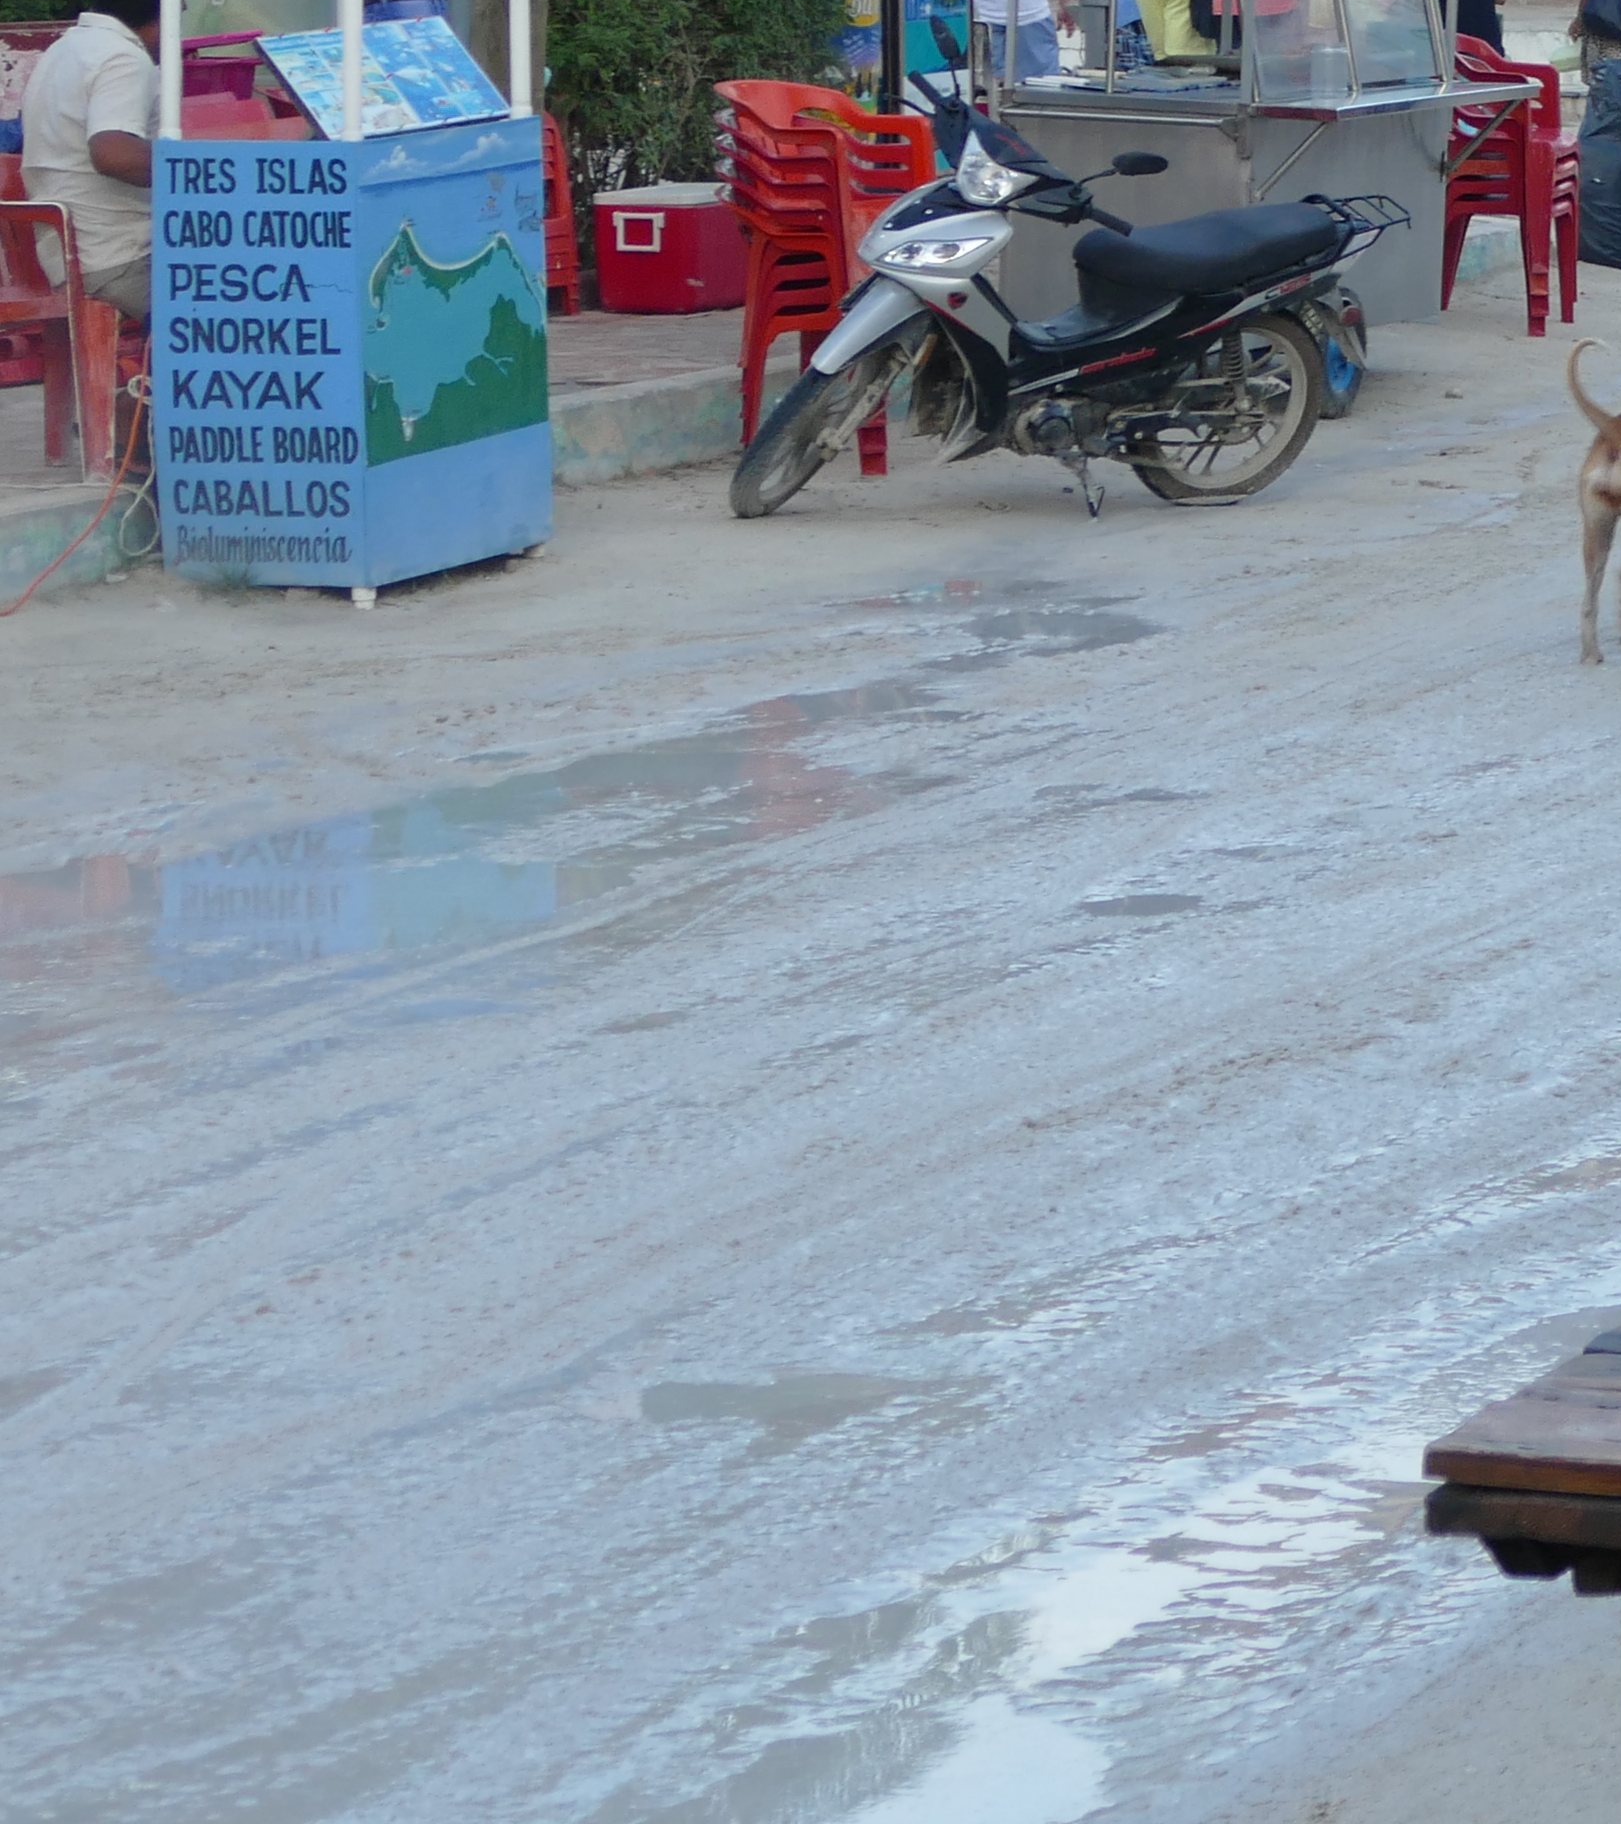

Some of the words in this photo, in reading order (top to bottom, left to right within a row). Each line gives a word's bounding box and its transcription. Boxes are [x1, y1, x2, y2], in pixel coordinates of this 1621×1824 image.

[166, 157, 237, 195] TRES
[255, 157, 348, 195] ISLAS
[163, 210, 232, 248] CABO
[243, 210, 352, 249] CATOCHE
[169, 263, 311, 302] PESCA
[169, 317, 342, 356] SNORKEL
[172, 370, 325, 410] KAYAK
[169, 426, 264, 464] PADDLE
[274, 426, 359, 465] BOARD
[173, 479, 351, 518] CABALLOS
